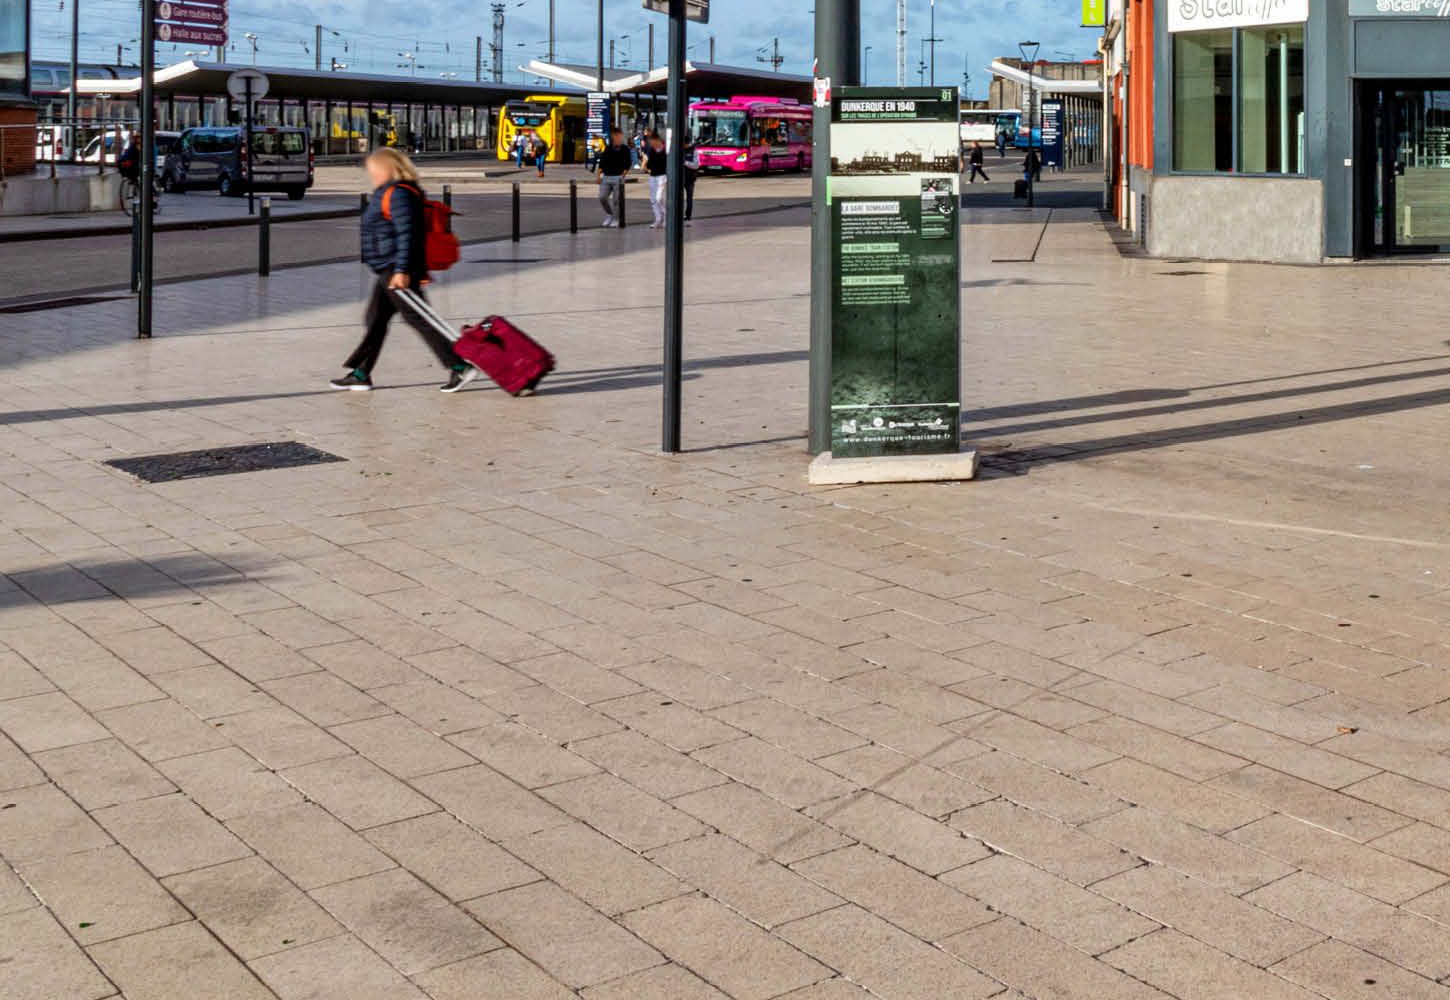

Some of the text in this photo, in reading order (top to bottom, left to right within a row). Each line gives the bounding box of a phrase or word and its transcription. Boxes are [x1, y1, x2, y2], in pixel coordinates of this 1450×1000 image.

[841, 102, 916, 112] DUNKERQUE EN 1940
